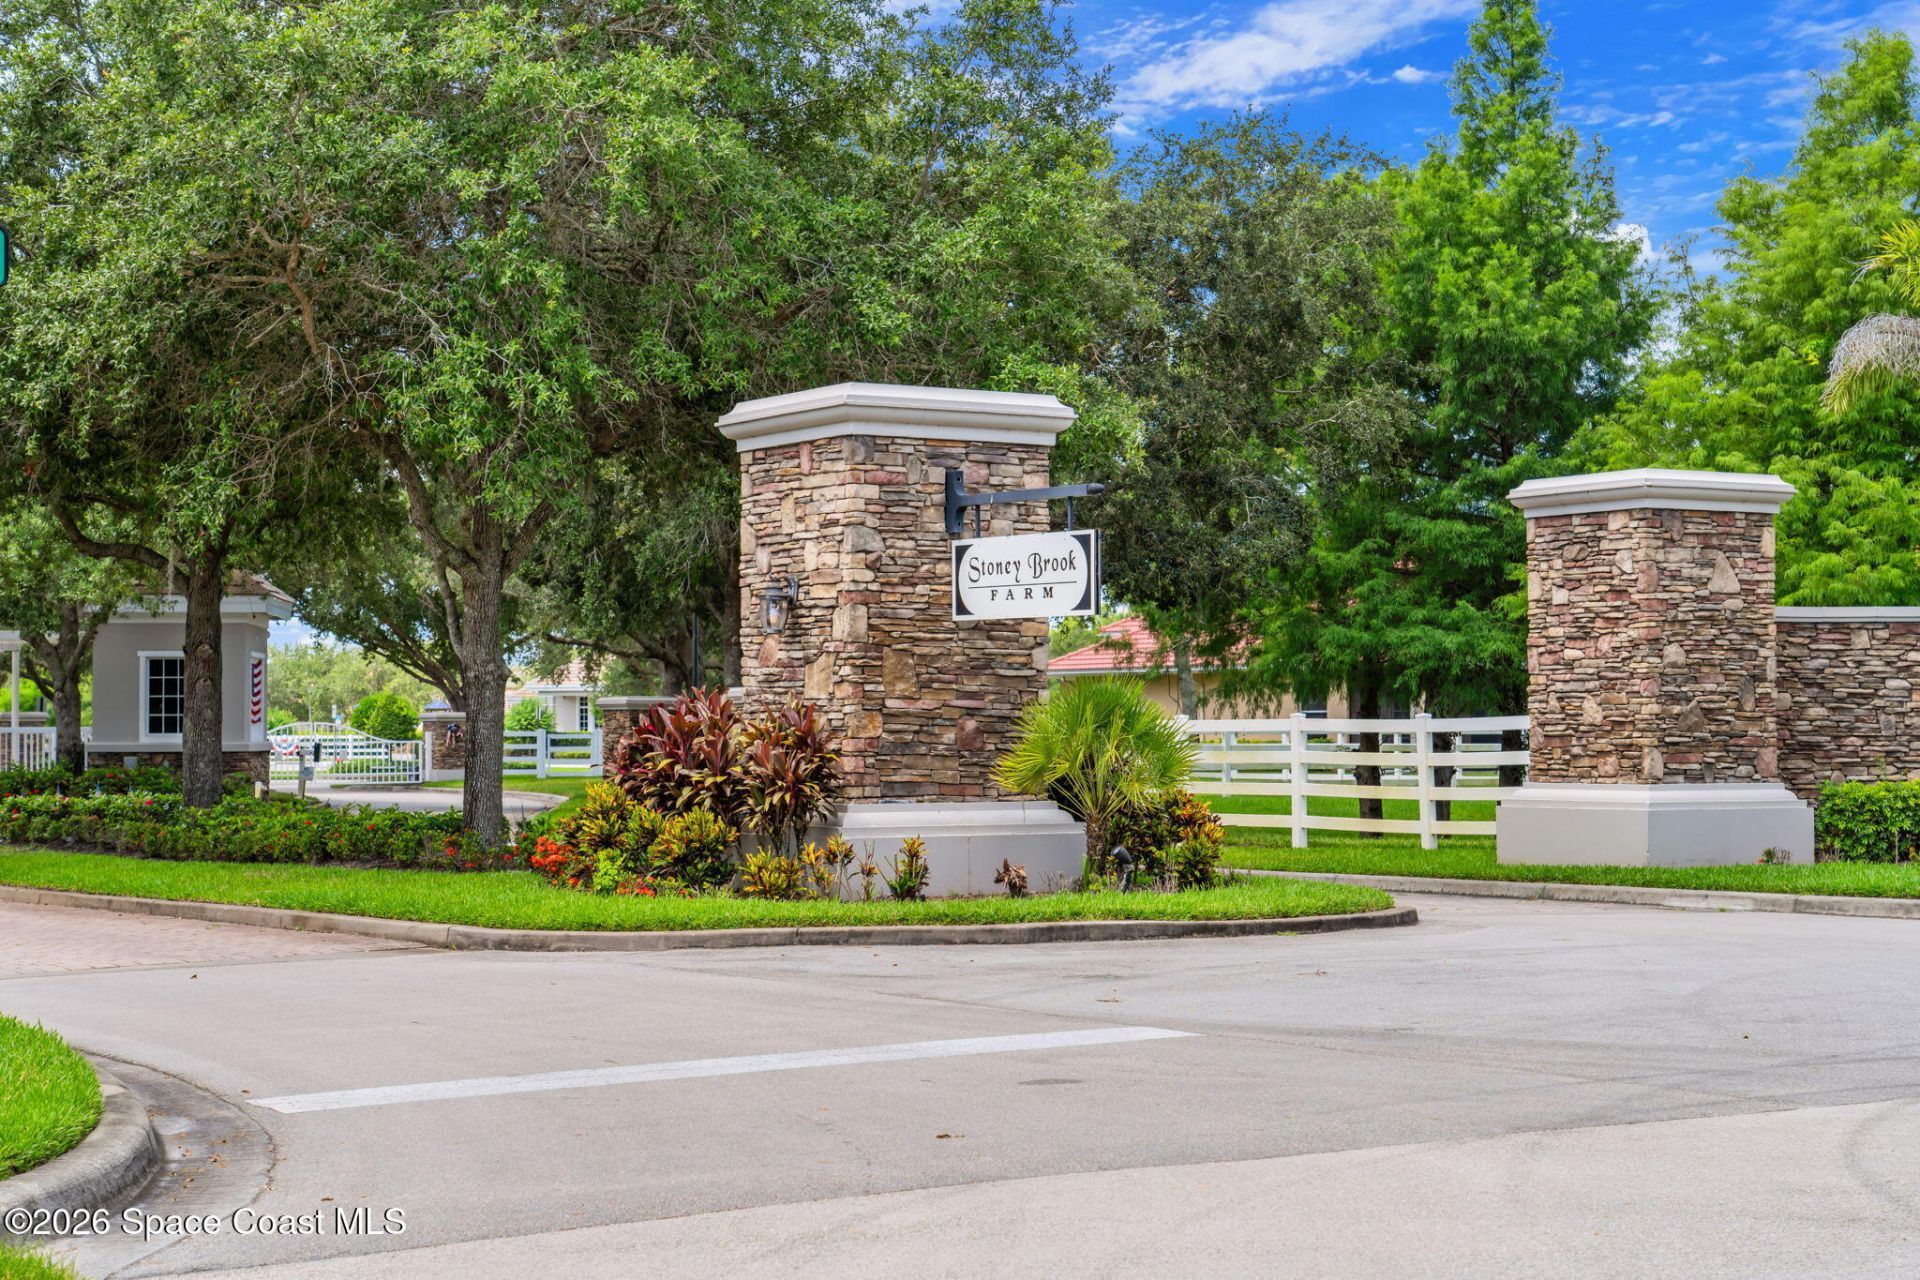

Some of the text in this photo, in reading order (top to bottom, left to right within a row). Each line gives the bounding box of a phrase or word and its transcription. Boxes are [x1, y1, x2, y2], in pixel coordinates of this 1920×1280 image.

[968, 550, 1077, 583] Stoney Brook
[990, 586, 1054, 601] FARM
